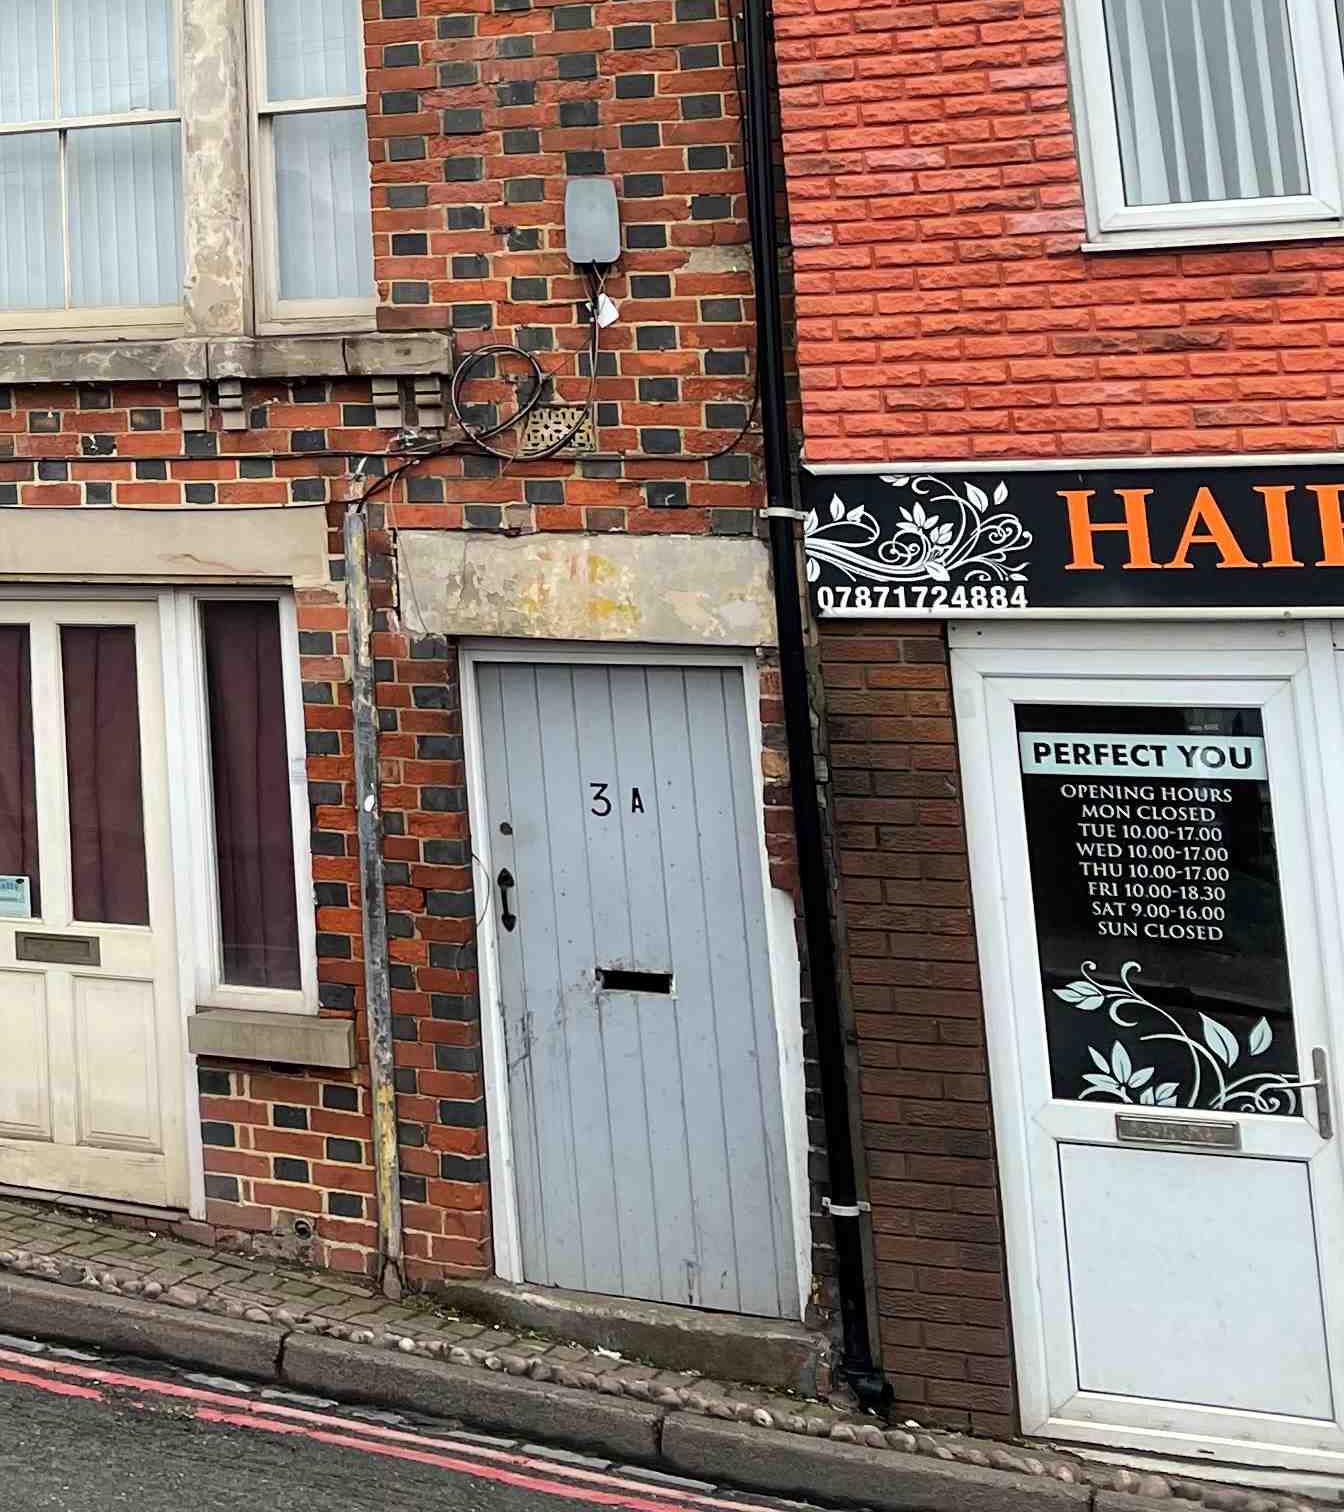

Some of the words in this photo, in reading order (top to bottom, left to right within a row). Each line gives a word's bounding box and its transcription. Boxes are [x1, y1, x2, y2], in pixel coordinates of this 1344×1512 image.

[817, 585, 1028, 609] 07871724884
[1033, 742, 1168, 768] PERFECT
[1176, 744, 1253, 770] YOU
[1060, 783, 1155, 802] OPENING
[1161, 787, 1233, 803] HOURS
[1081, 804, 1131, 820] MON
[1136, 806, 1216, 823] CLOSED
[1077, 822, 1117, 838] TUE
[1122, 824, 1223, 842] 10.00-17.00
[1075, 842, 1123, 858] WED
[1127, 844, 1229, 862] 10.00-17.00
[1078, 861, 1123, 877] THU
[1128, 864, 1230, 882] 10.00-17.00
[1087, 881, 1118, 897] FRI
[1124, 883, 1226, 901] 10.00-18.30
[1092, 901, 1126, 917] SAT
[1130, 902, 1225, 921] 9.00-16.00
[1098, 920, 1138, 937] SUN
[1143, 922, 1224, 941] CLOSED
